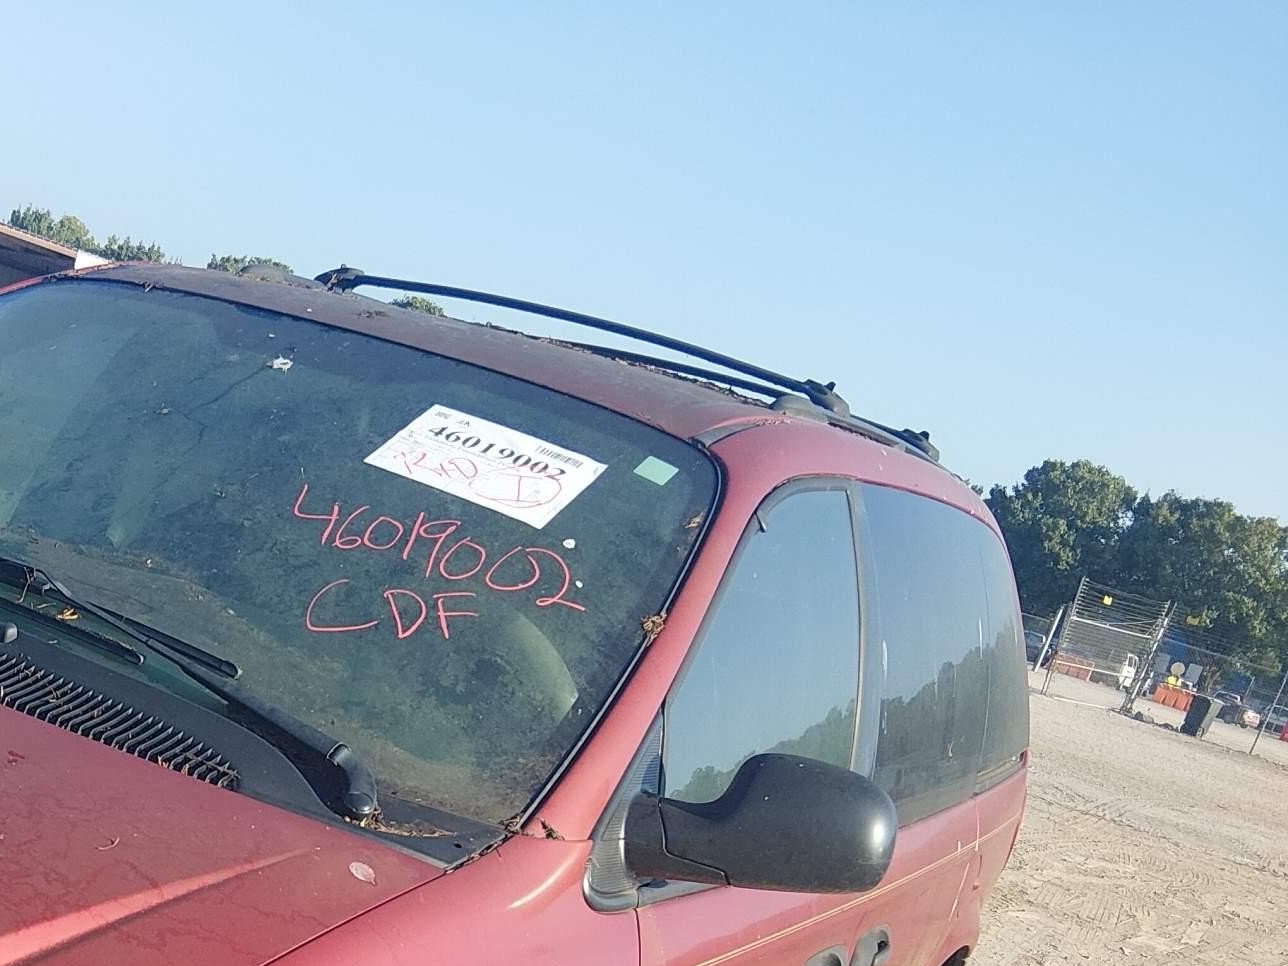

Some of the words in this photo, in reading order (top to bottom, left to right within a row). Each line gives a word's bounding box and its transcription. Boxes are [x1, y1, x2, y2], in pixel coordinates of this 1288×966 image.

[428, 426, 566, 480] 46019002
[294, 484, 586, 612] 46019002
[306, 579, 480, 639] CDF
